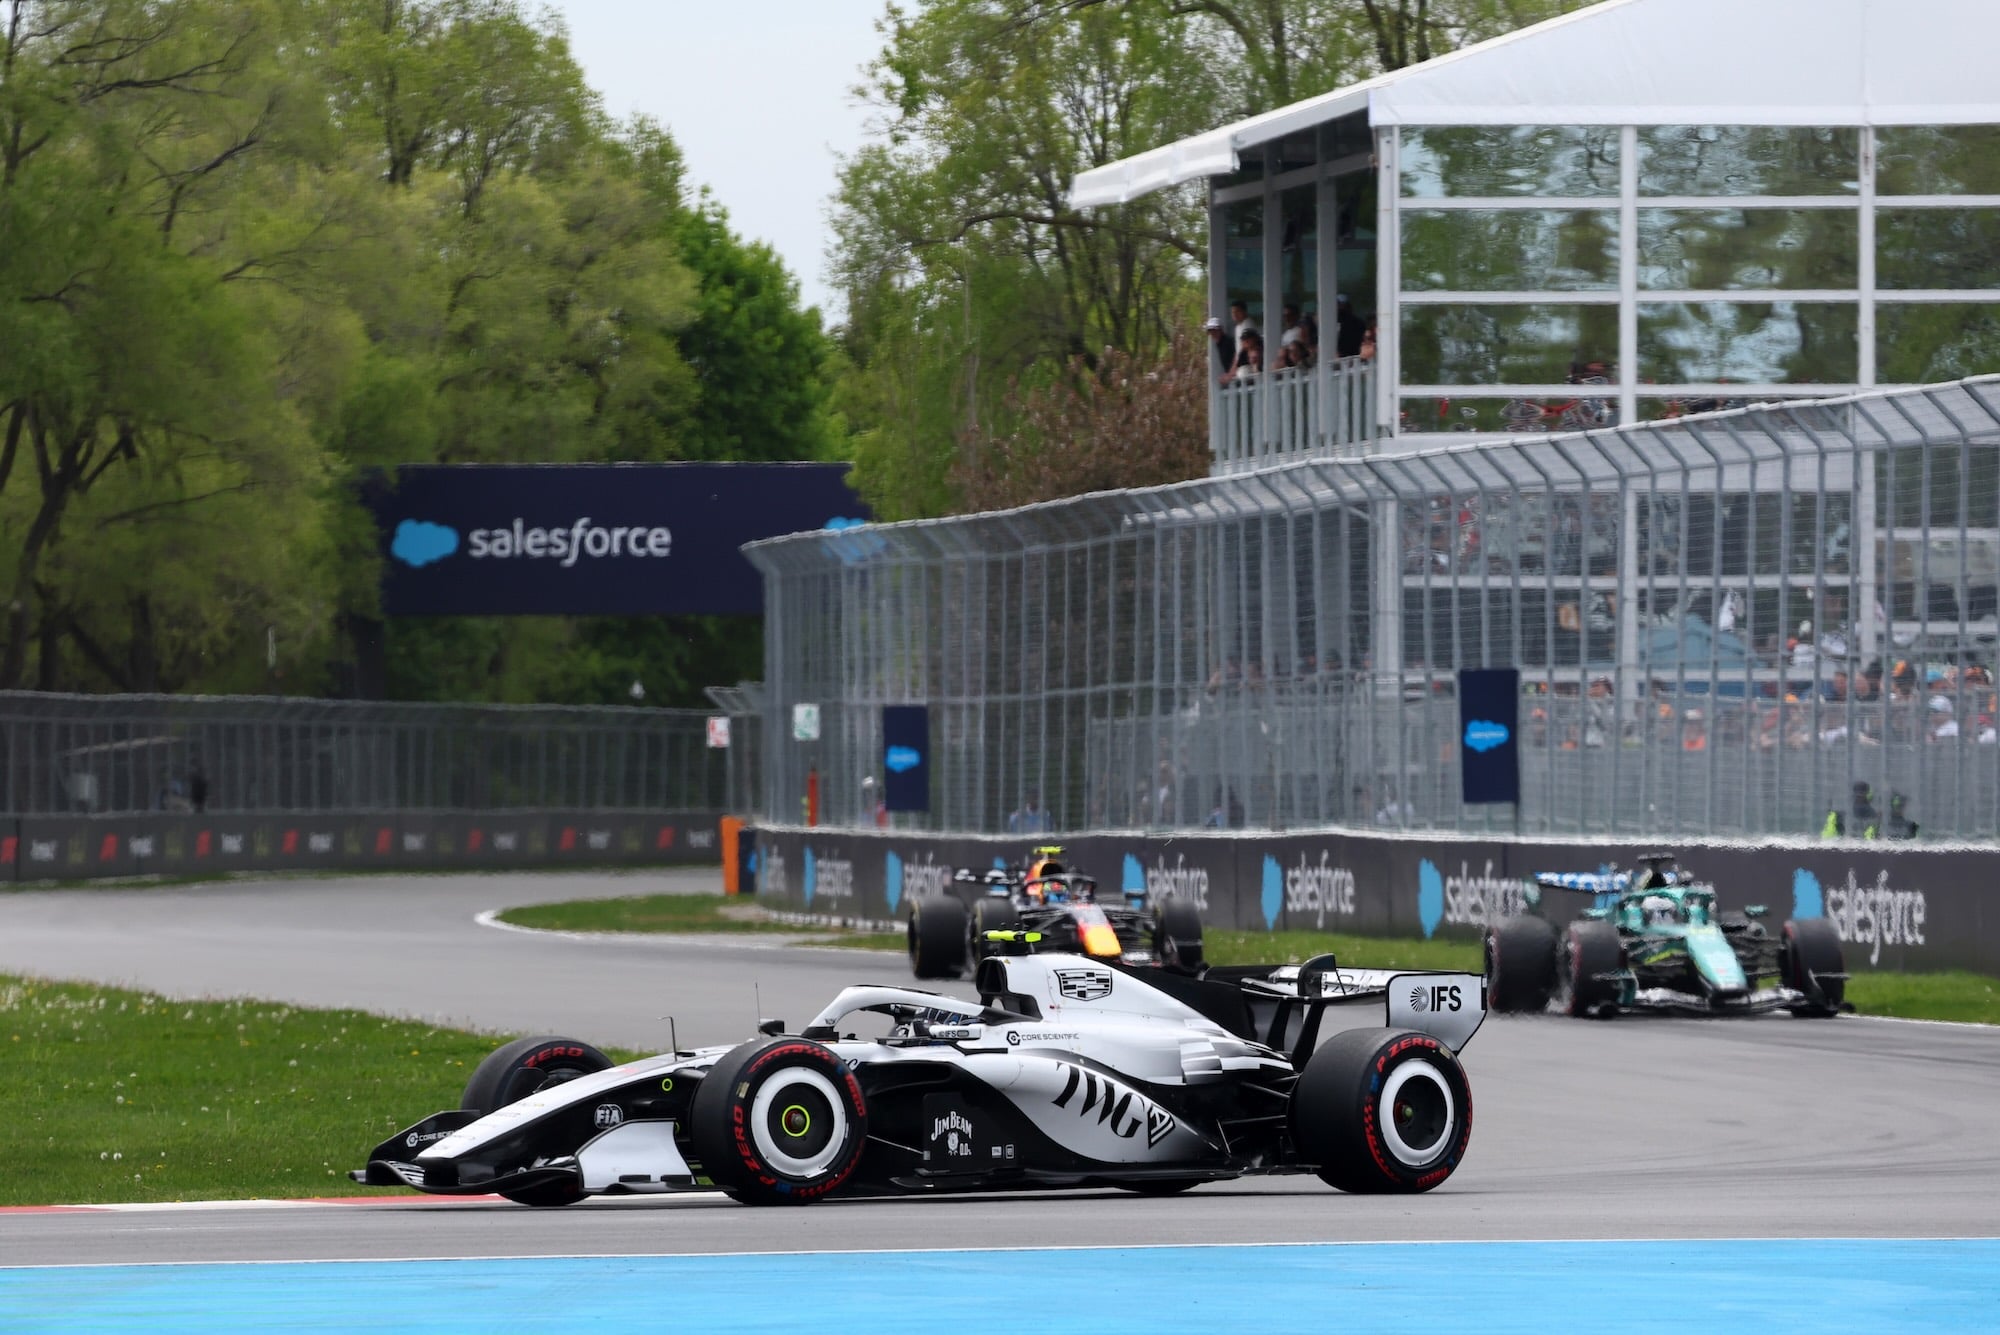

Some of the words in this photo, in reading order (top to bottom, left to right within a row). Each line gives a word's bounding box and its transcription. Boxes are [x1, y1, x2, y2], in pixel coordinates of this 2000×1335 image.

[467, 517, 672, 567] salesforce
[1286, 849, 1355, 929] salesforce
[1827, 867, 1926, 967] salesforce
[1430, 985, 1462, 1013] IFS
[1021, 1033, 1042, 1042] CORE
[1042, 1032, 1080, 1041] SCIENTIFIC
[1388, 1037, 1437, 1058] ZERO
[523, 1046, 584, 1068] ZERO
[1051, 1061, 1144, 1138] TWG
[595, 1108, 621, 1125] FIA
[930, 1116, 950, 1141] JIM
[950, 1110, 973, 1140] BEAM
[418, 1132, 437, 1142] CORE
[733, 1104, 761, 1172] ZERO
